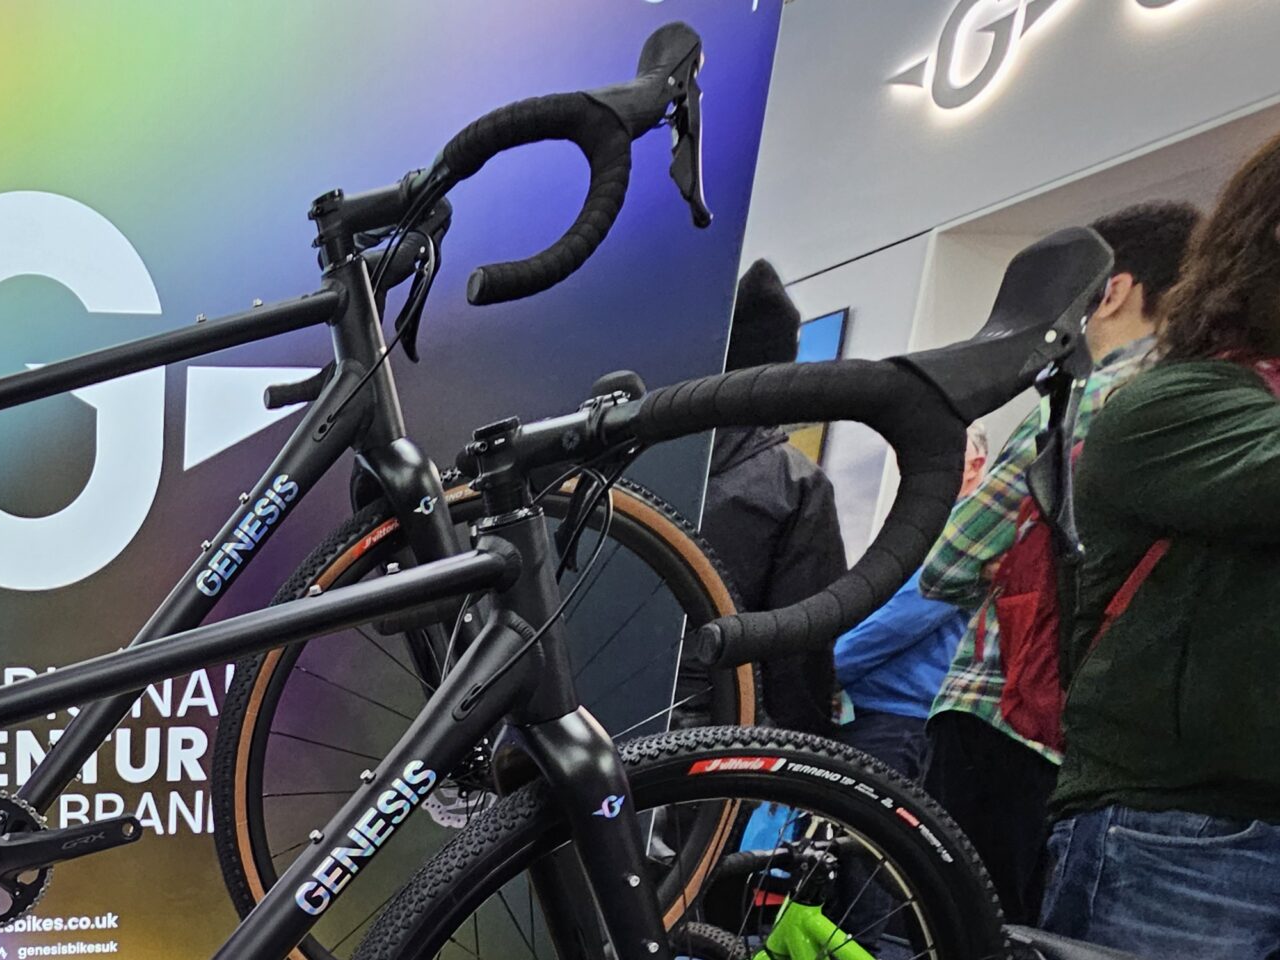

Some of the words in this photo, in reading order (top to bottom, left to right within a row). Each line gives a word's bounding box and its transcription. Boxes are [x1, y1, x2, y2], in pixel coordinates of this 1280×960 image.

[196, 474, 300, 598] GENESIS
[786, 762, 840, 783] TERRENO
[59, 790, 215, 837] BRAN
[295, 759, 437, 916] GENESIS
[18, 940, 119, 960] genesisbikesuk
